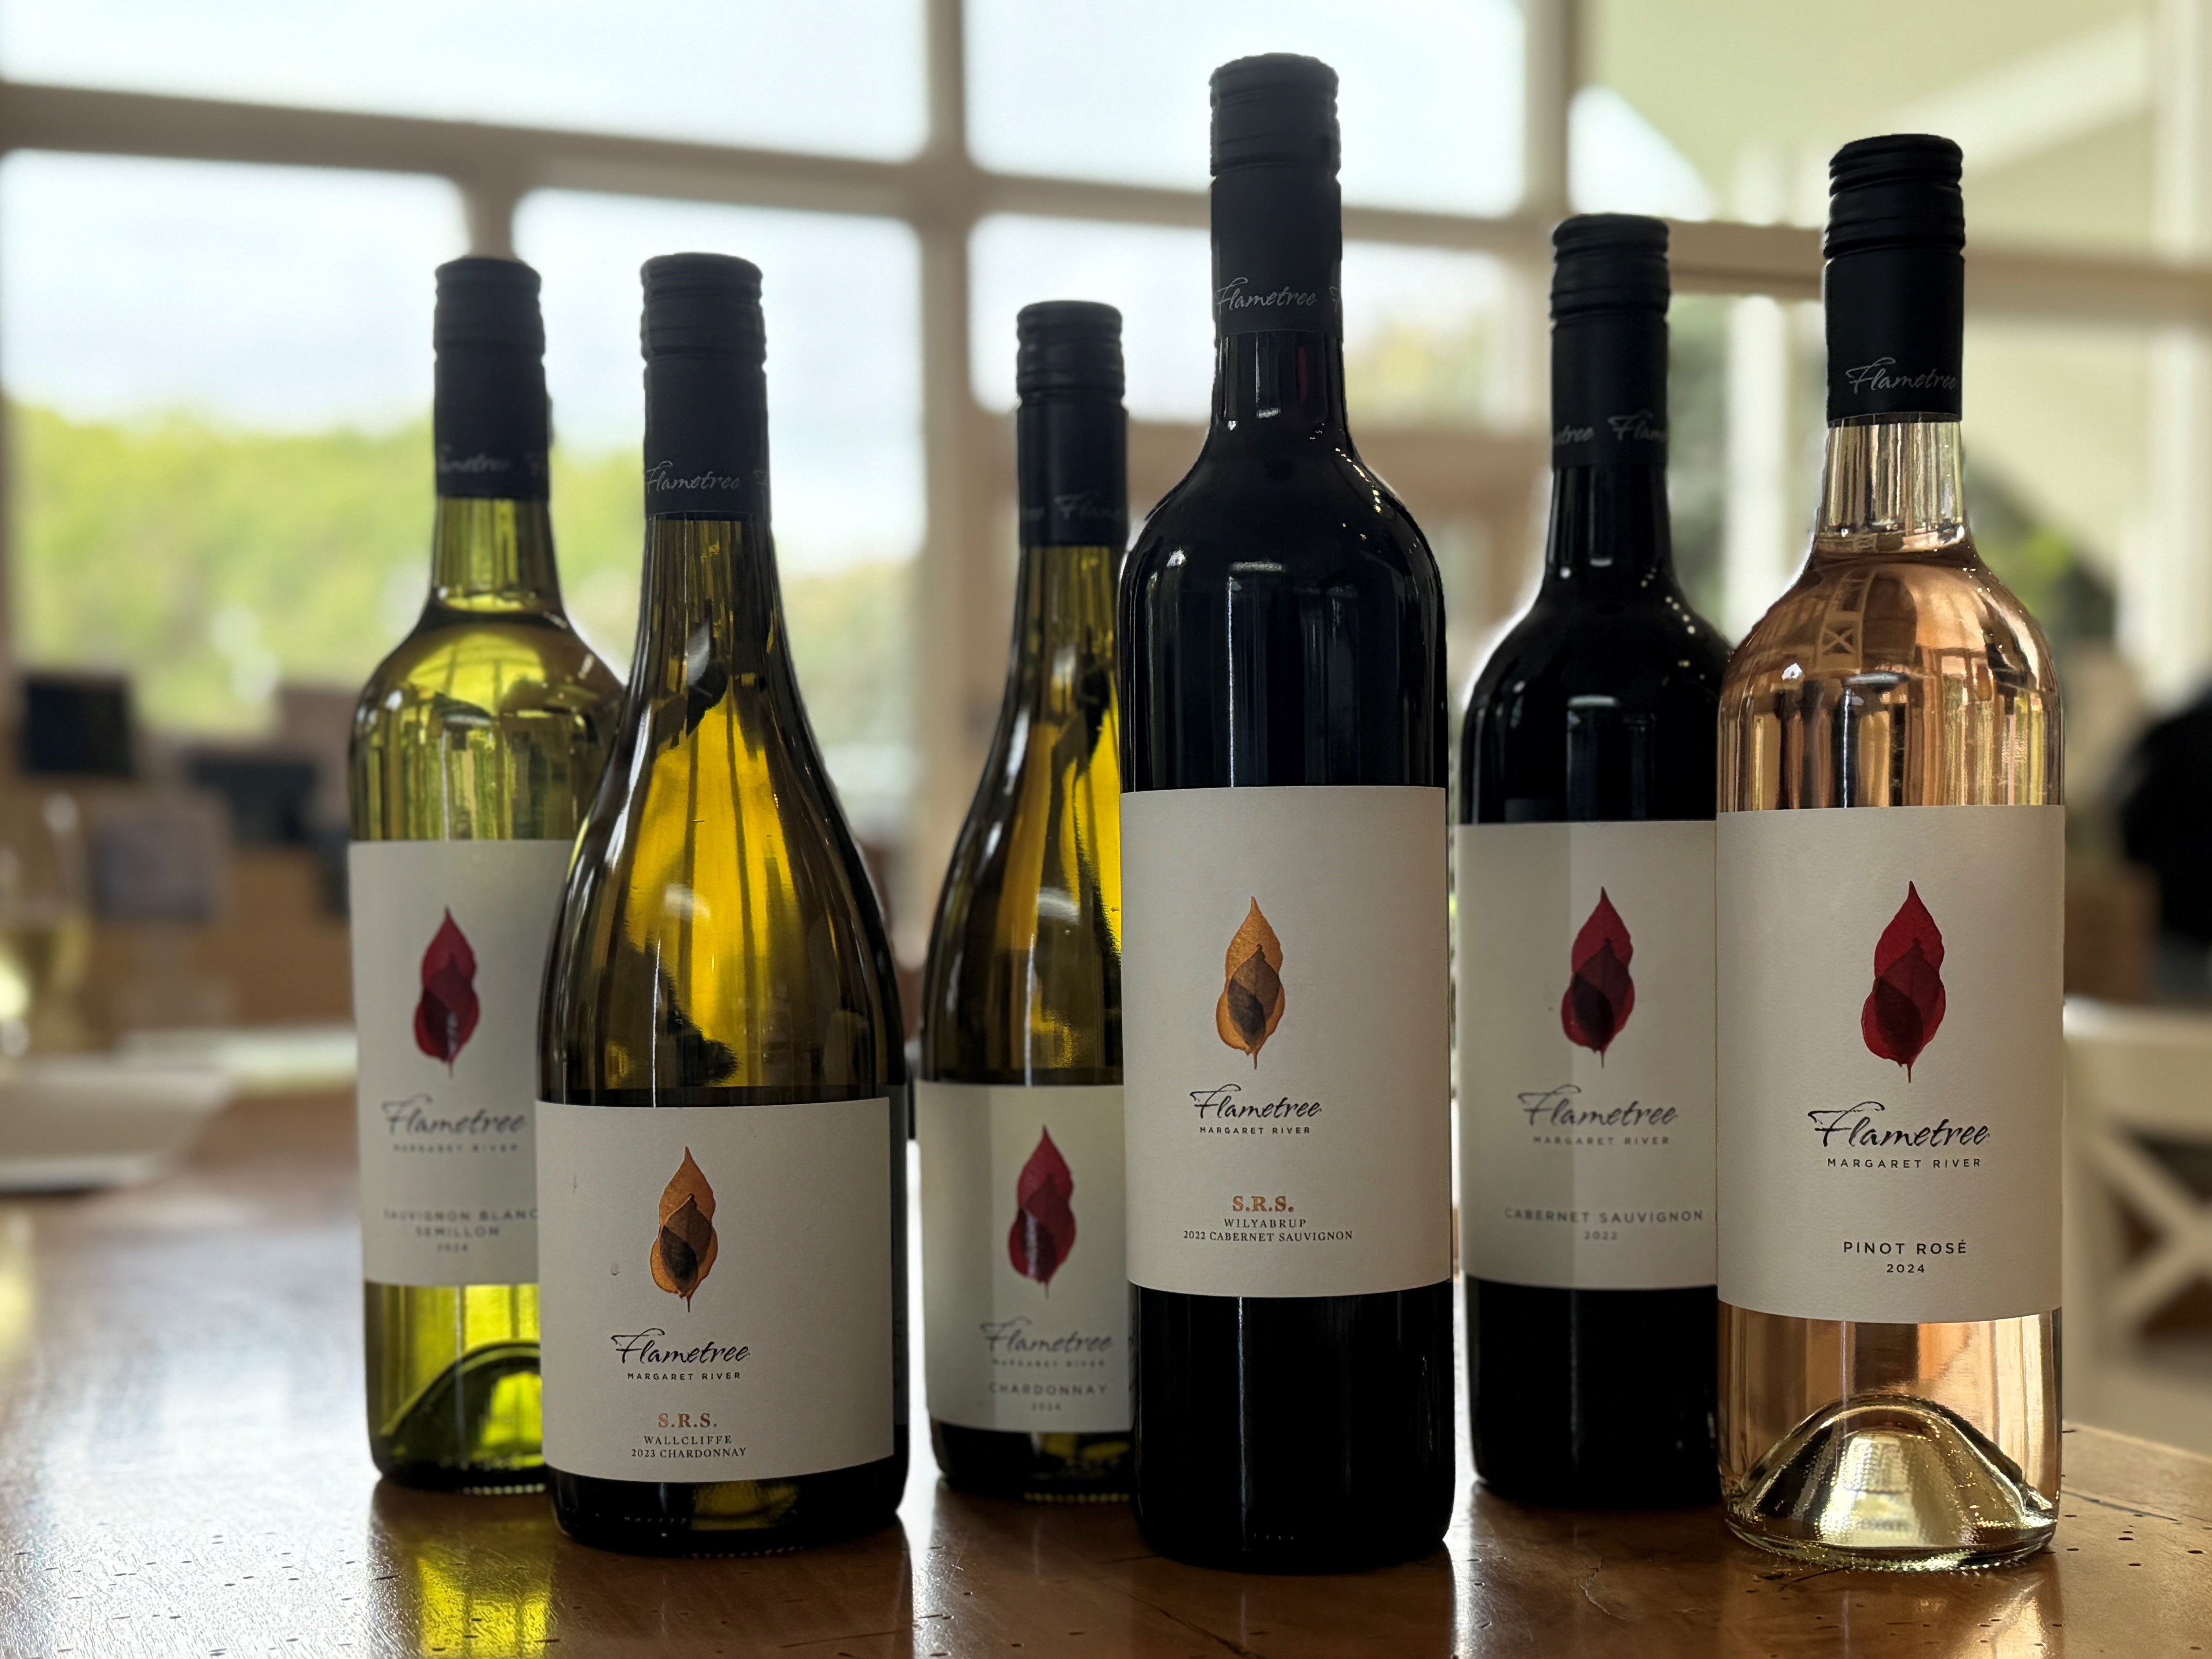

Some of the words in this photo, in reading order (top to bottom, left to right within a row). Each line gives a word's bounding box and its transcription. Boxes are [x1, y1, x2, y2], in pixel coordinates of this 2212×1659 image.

[1214, 277, 1317, 314] Flametree
[1845, 357, 1958, 394] Flametree
[646, 460, 741, 494] Flametree
[1189, 1083, 1322, 1118] Flametree
[1518, 1084, 1677, 1127] Flametree
[381, 1093, 525, 1136] Flametree
[1808, 1101, 1990, 1147] Flametree
[1534, 1136, 1615, 1145] MARGARET
[1828, 1158, 1922, 1168] MARGARET
[1933, 1158, 1980, 1168] RIVER
[1232, 1195, 1294, 1212] S.R.S.
[384, 1207, 470, 1221] SAUVIGNON
[1505, 1208, 1590, 1223] CABERNET
[1600, 1210, 1703, 1223] SAUVIGNON
[1224, 1219, 1306, 1228] WILYABRUP
[416, 1226, 500, 1237] SEMILLON
[1183, 1231, 1205, 1240] 2022
[1210, 1232, 1274, 1242] CABERNET
[1279, 1231, 1352, 1242] SAUVIGNON
[1584, 1231, 1618, 1241] 2022
[1844, 1241, 1905, 1254] PINOT
[1917, 1239, 1967, 1254] ROSÉ
[1887, 1264, 1925, 1273] 2024
[980, 1316, 1113, 1353] Flametree
[611, 1328, 750, 1364] Flametree
[989, 1383, 1107, 1395] CHARDONNAY
[658, 1413, 718, 1428] S.R.S.
[644, 1435, 732, 1445] WALLCLIFFE
[632, 1449, 655, 1458] 2023
[660, 1448, 747, 1458] CHARDONNAY
